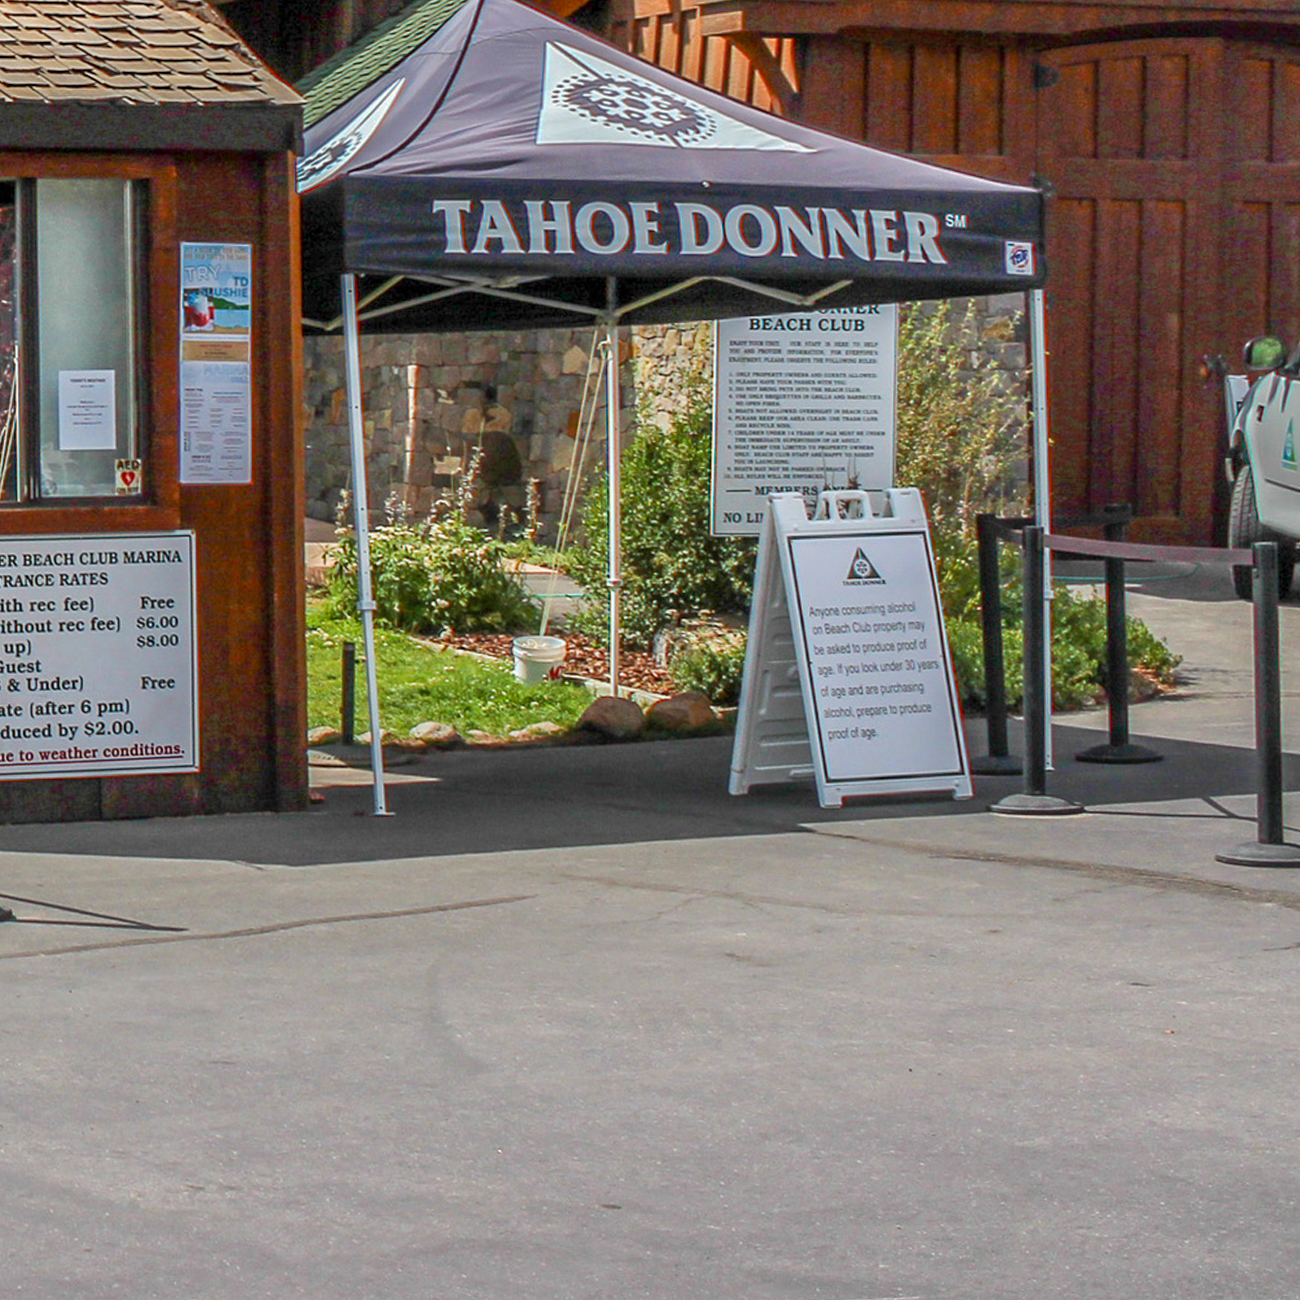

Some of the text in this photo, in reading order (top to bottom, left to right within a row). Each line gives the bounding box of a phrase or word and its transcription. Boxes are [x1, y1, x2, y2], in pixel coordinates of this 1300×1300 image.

[432, 200, 670, 256] TAHOE
[679, 202, 948, 264] DONNER
[945, 213, 967, 228] SM
[184, 263, 222, 282] TRY
[749, 318, 865, 332] BEACH CLUB
[116, 460, 140, 470] AED
[723, 513, 742, 523] NO
[22, 552, 75, 566] BEACH
[79, 552, 118, 566] CLUB
[123, 550, 182, 564] MARINA
[59, 572, 108, 586] RATES
[29, 601, 56, 612] rec
[64, 597, 94, 612] fee)
[140, 596, 175, 609] Free
[810, 602, 916, 619] Anyone consuming alcohol
[58, 620, 84, 632] rec
[90, 616, 120, 632] fee)
[136, 616, 179, 630] $6.00
[812, 621, 925, 635] on Beach Club property may
[4, 640, 31, 658] up)
[136, 634, 179, 648] $8.00
[814, 638, 927, 655] be asked to produce proof of
[844, 664, 860, 676] you
[862, 662, 880, 672] look
[881, 661, 903, 672] under
[904, 660, 916, 670] 30
[917, 660, 939, 672] years
[7, 678, 20, 692] &
[27, 676, 84, 692] Under)
[141, 676, 175, 689] Free
[820, 683, 924, 699] of age and are purchasing
[30, 701, 75, 718] (after
[80, 700, 92, 714] 6
[97, 698, 130, 716] pm)
[856, 706, 888, 718] prepare
[889, 704, 898, 714] to
[900, 703, 932, 716] produce
[58, 723, 78, 740] by
[84, 720, 139, 736] $2.00.
[828, 728, 848, 740] proof
[850, 727, 859, 738] of
[19, 750, 34, 761] to
[39, 746, 98, 761] weather
[103, 743, 185, 758] conditions.
